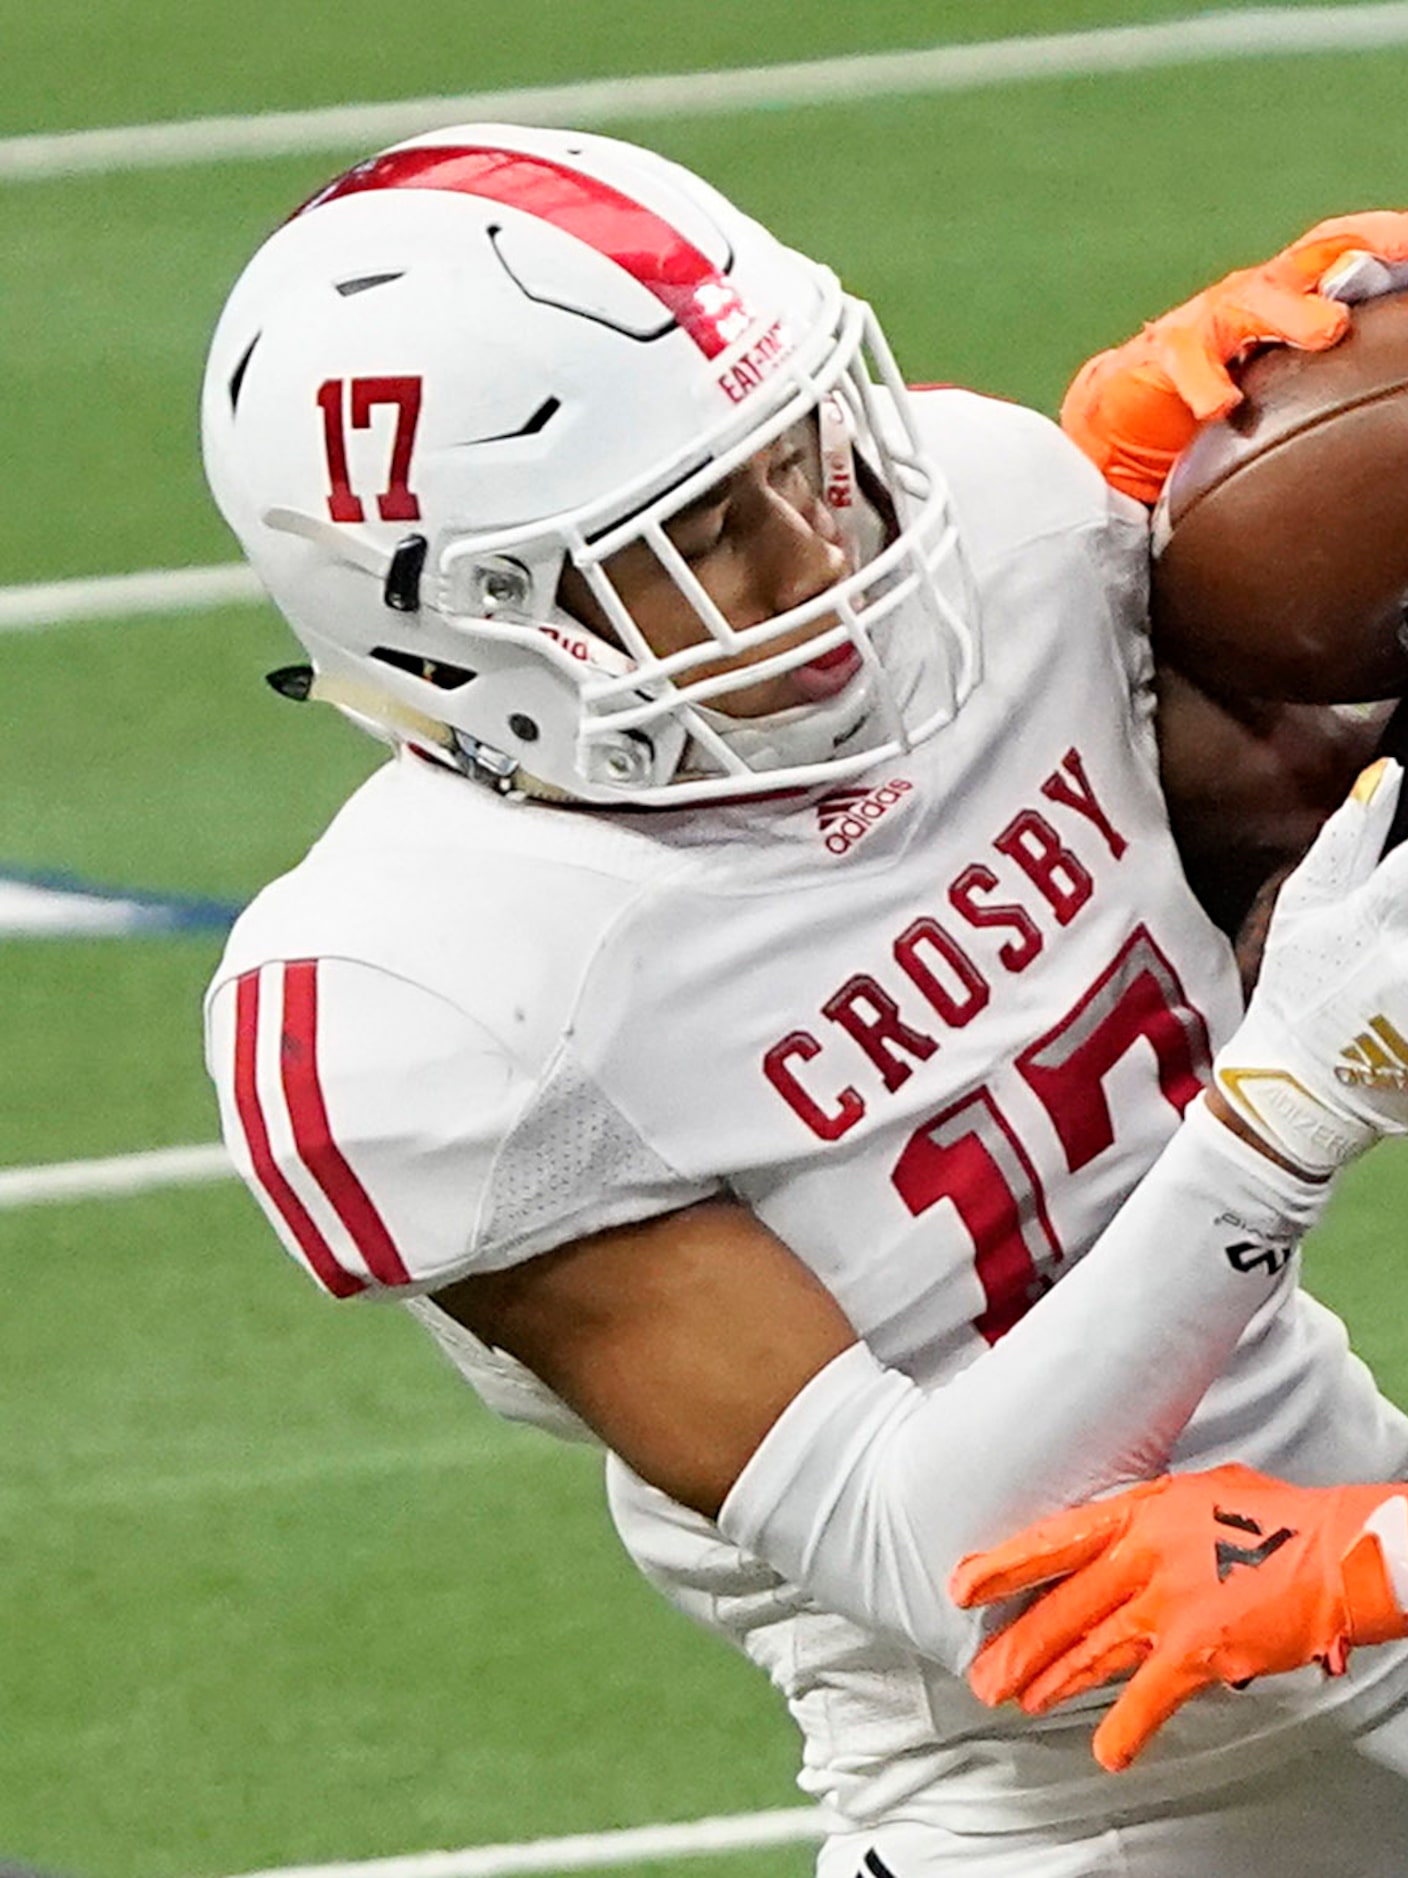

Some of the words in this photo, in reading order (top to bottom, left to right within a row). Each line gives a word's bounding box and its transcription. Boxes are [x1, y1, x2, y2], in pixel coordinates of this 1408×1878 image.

[317, 376, 422, 522] 17
[763, 747, 1127, 1141] CROSBY
[825, 779, 913, 855] adidas
[891, 922, 1214, 1348] 17
